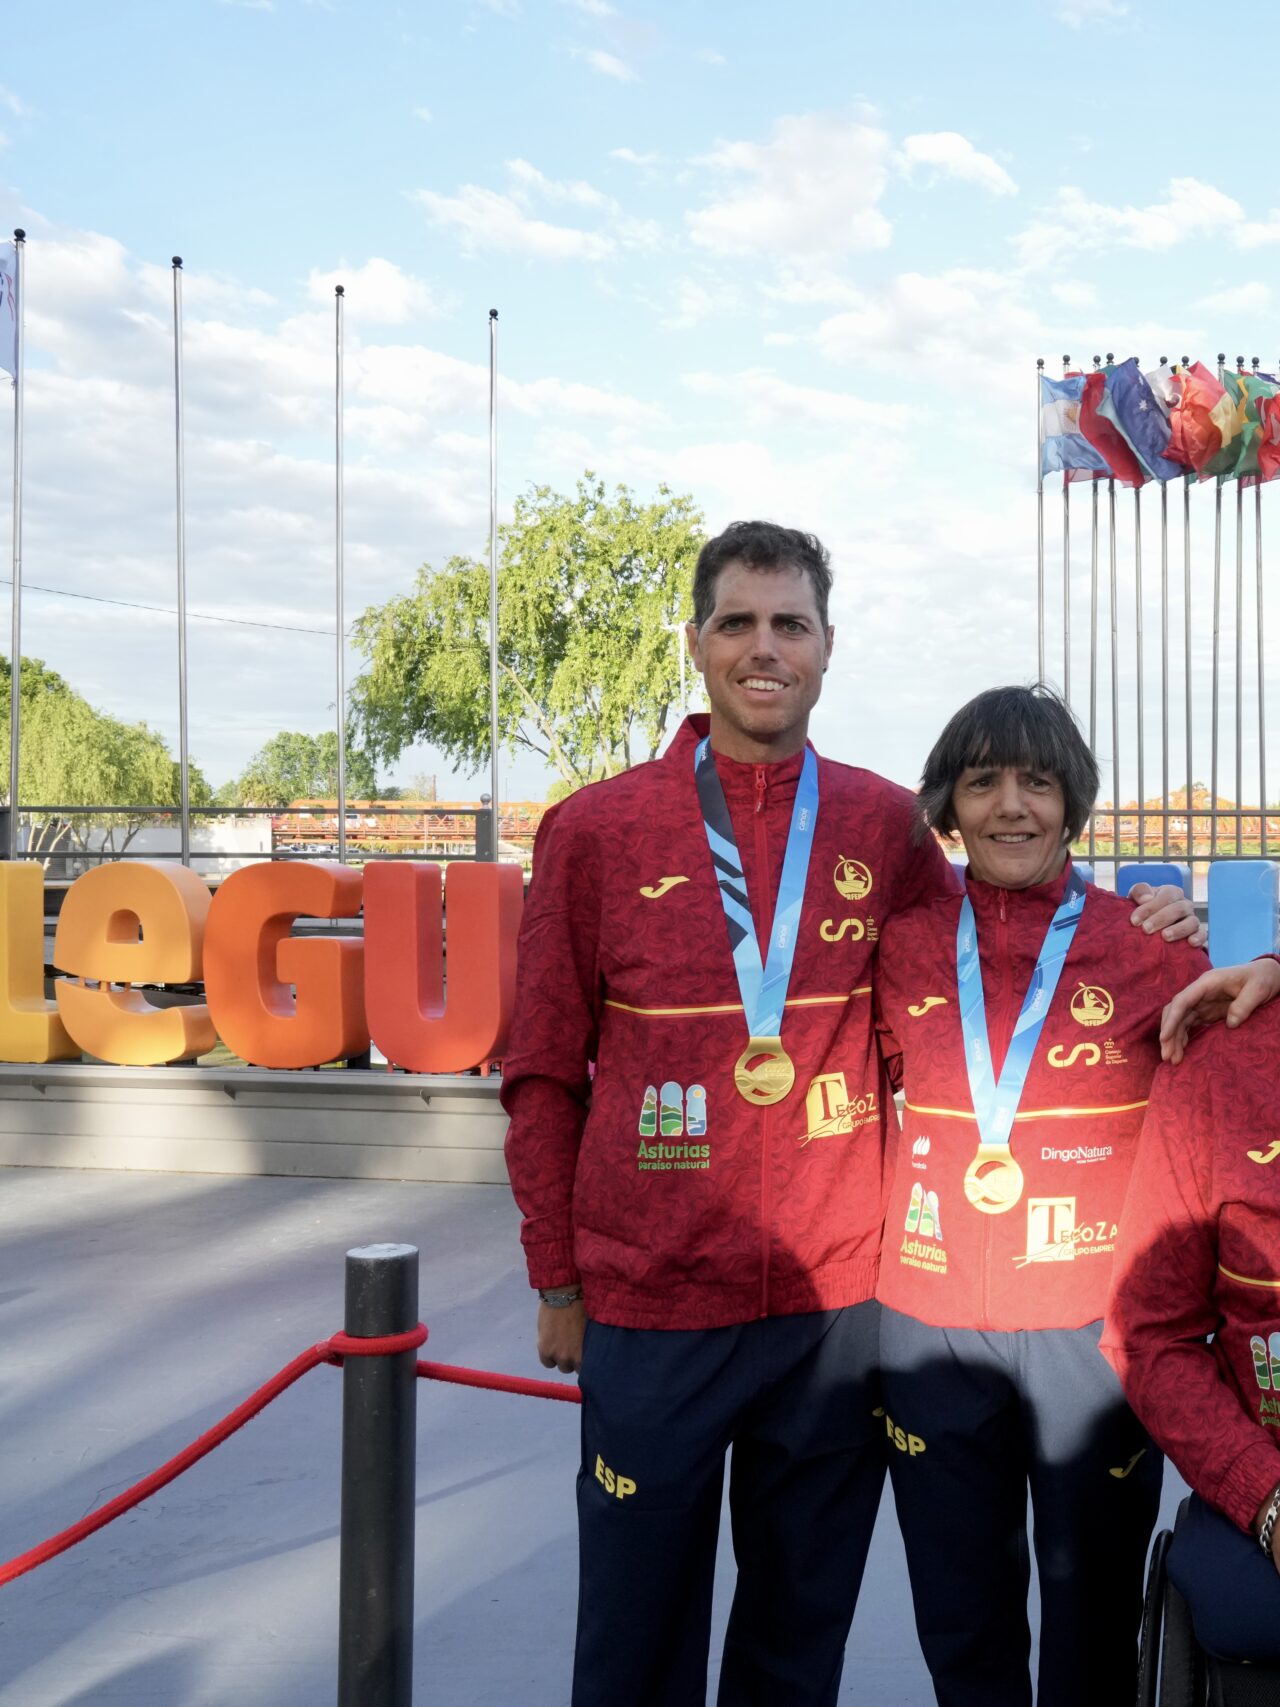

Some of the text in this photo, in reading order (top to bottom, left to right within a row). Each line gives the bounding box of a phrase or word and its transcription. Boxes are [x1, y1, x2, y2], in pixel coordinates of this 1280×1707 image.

[637, 1139, 711, 1159] Asturias
[1041, 1145, 1113, 1162] DingoNatura
[673, 1159, 710, 1169] natural
[900, 1233, 948, 1263] Asturias
[921, 1259, 948, 1274] natural
[886, 1414, 927, 1457] ESP
[595, 1453, 637, 1499] ESP
